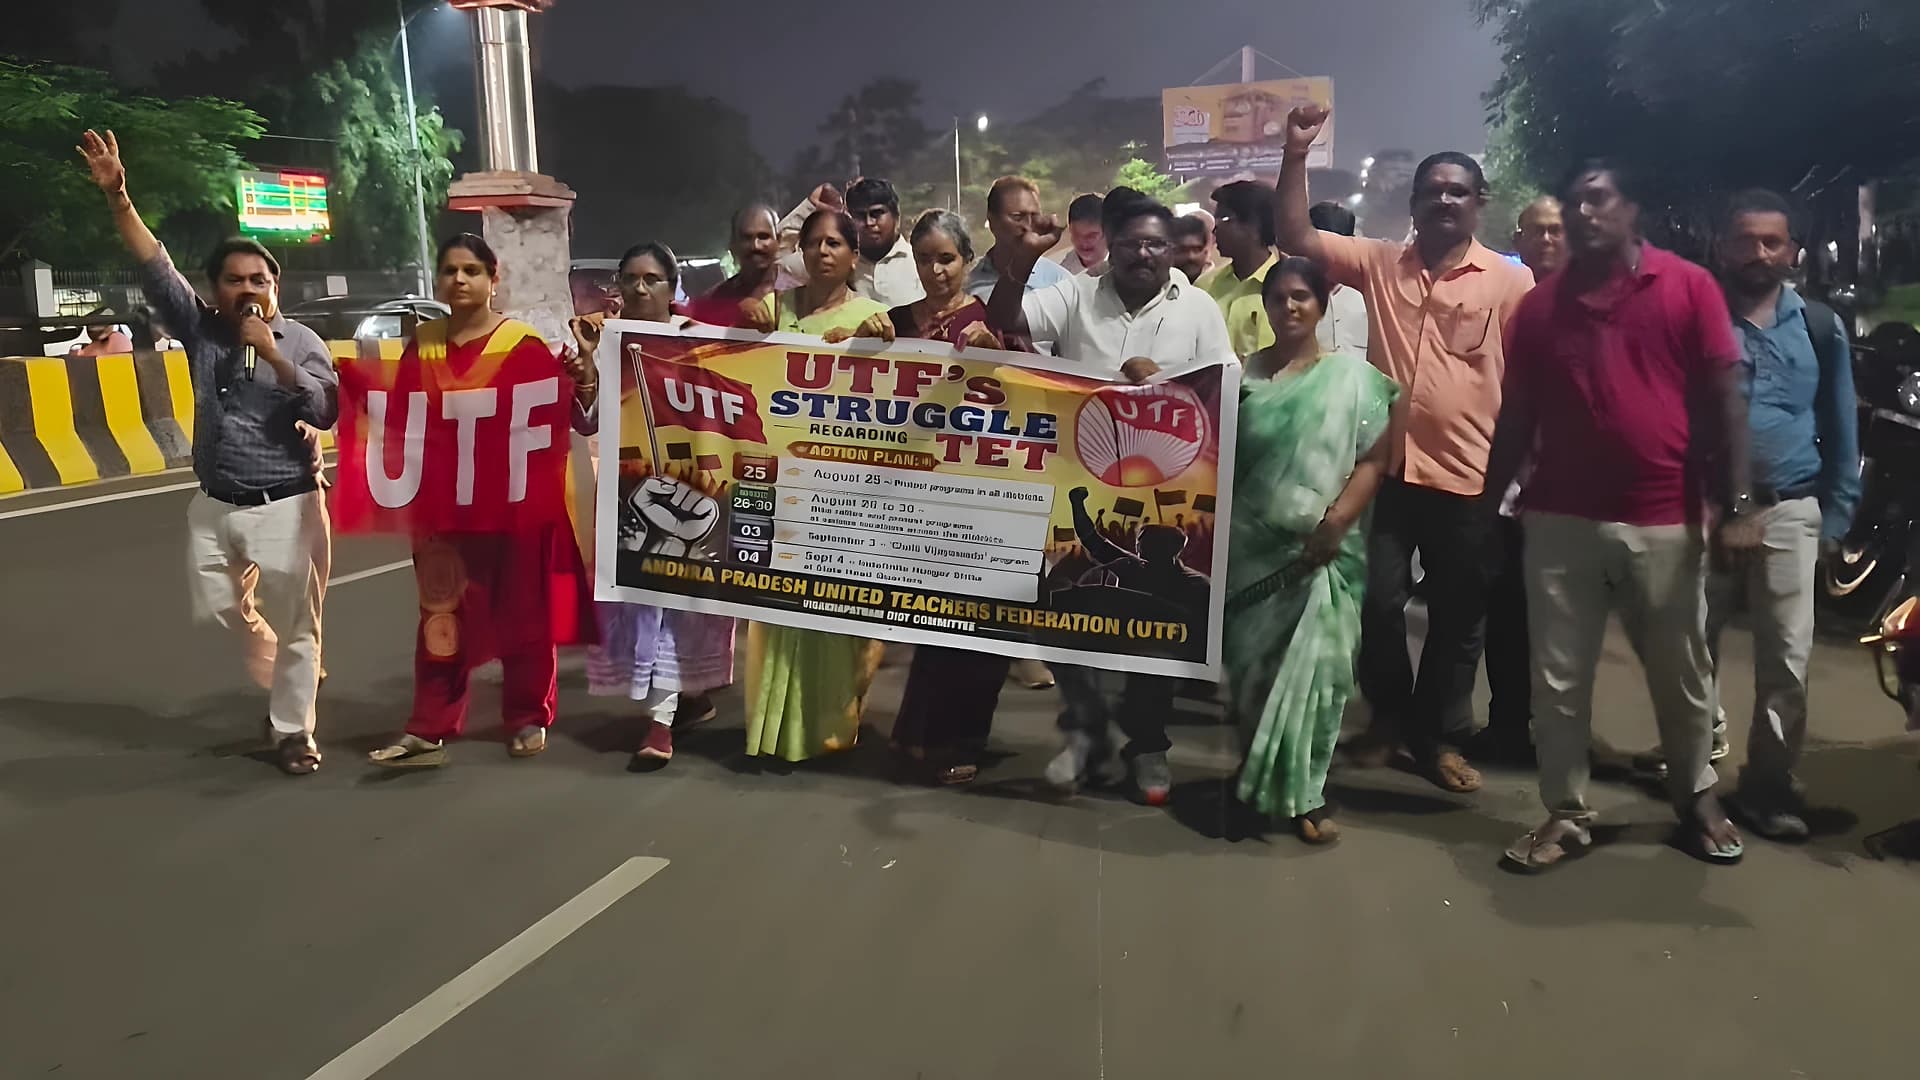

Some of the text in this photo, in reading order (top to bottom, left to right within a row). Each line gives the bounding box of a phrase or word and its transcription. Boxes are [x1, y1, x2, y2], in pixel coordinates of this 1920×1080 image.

[663, 377, 744, 425] UTF
[1114, 399, 1188, 428] UTF
[769, 390, 1058, 440] STRUGGLE
[365, 376, 559, 509] UTF
[809, 423, 908, 444] REGARDING
[809, 445, 868, 461] ACTION
[935, 433, 1058, 471] TET
[743, 465, 767, 480] 25
[741, 525, 761, 537] 03
[738, 549, 760, 563] 04
[641, 558, 1189, 643] ANDHRA PRADESH UNITED TEACHERS FEDERATION (UTF)
[913, 614, 976, 632] COMMITTEE
